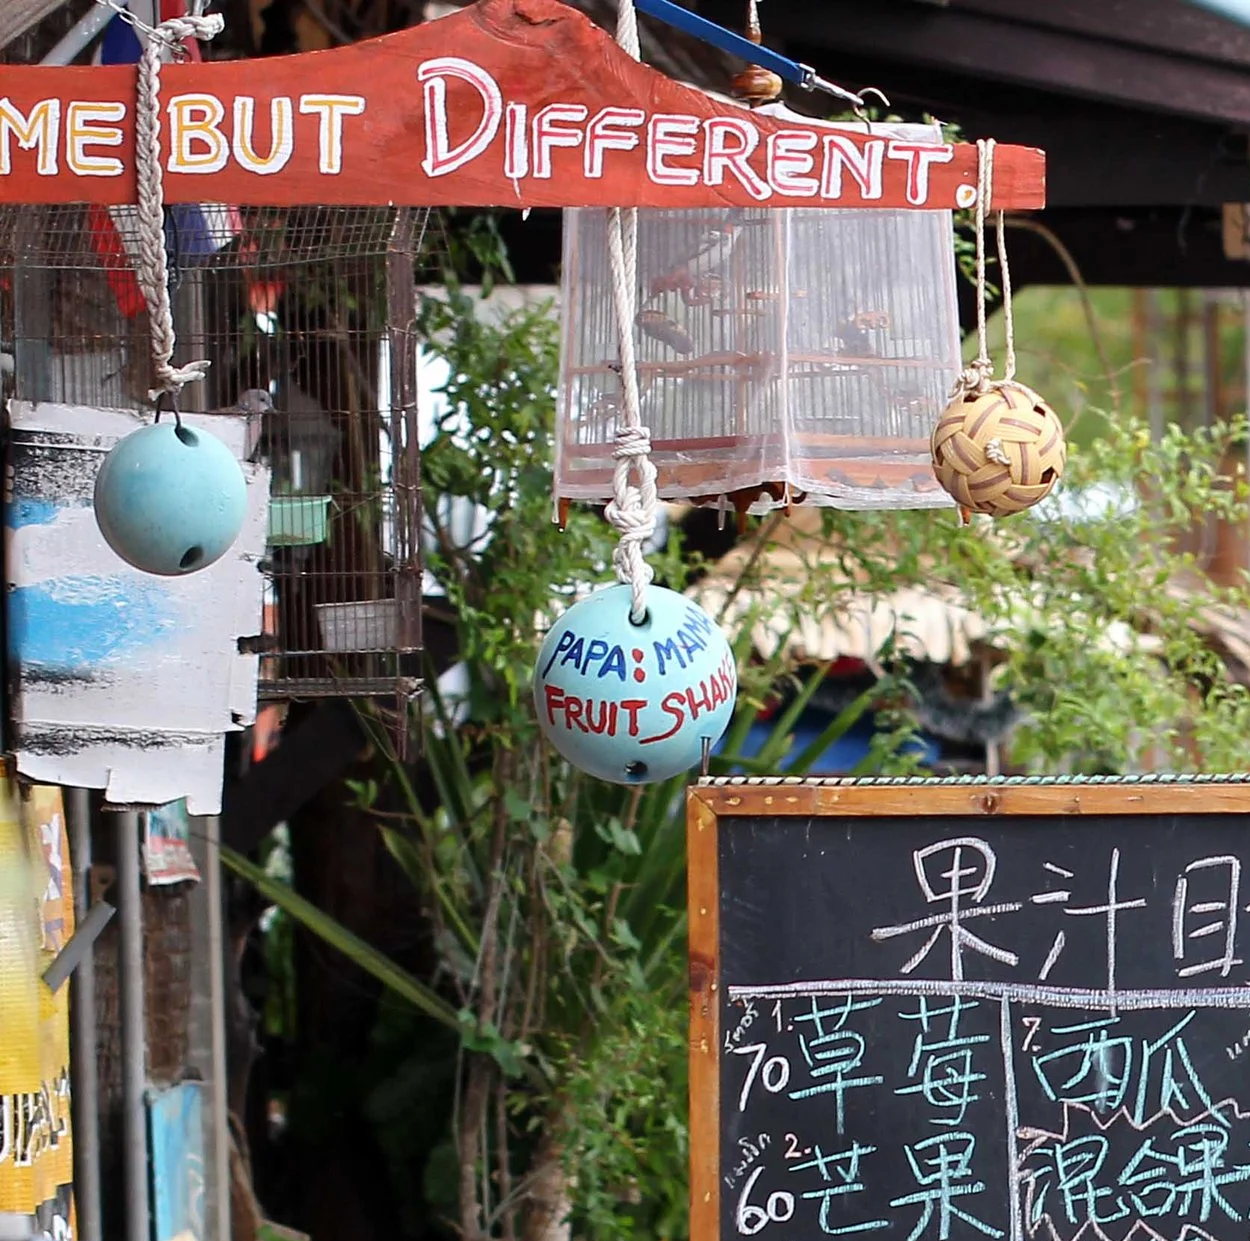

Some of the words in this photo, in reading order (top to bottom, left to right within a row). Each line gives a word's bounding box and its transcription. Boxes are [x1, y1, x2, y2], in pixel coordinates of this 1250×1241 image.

[166, 94, 365, 176] BUT
[545, 683, 648, 737] FRUIT
[639, 646, 736, 745] SHAKE
[732, 1043, 790, 1112] 70
[788, 995, 990, 1134] 草莓
[1032, 1010, 1232, 1128] 西瓜
[736, 1166, 795, 1235] 60
